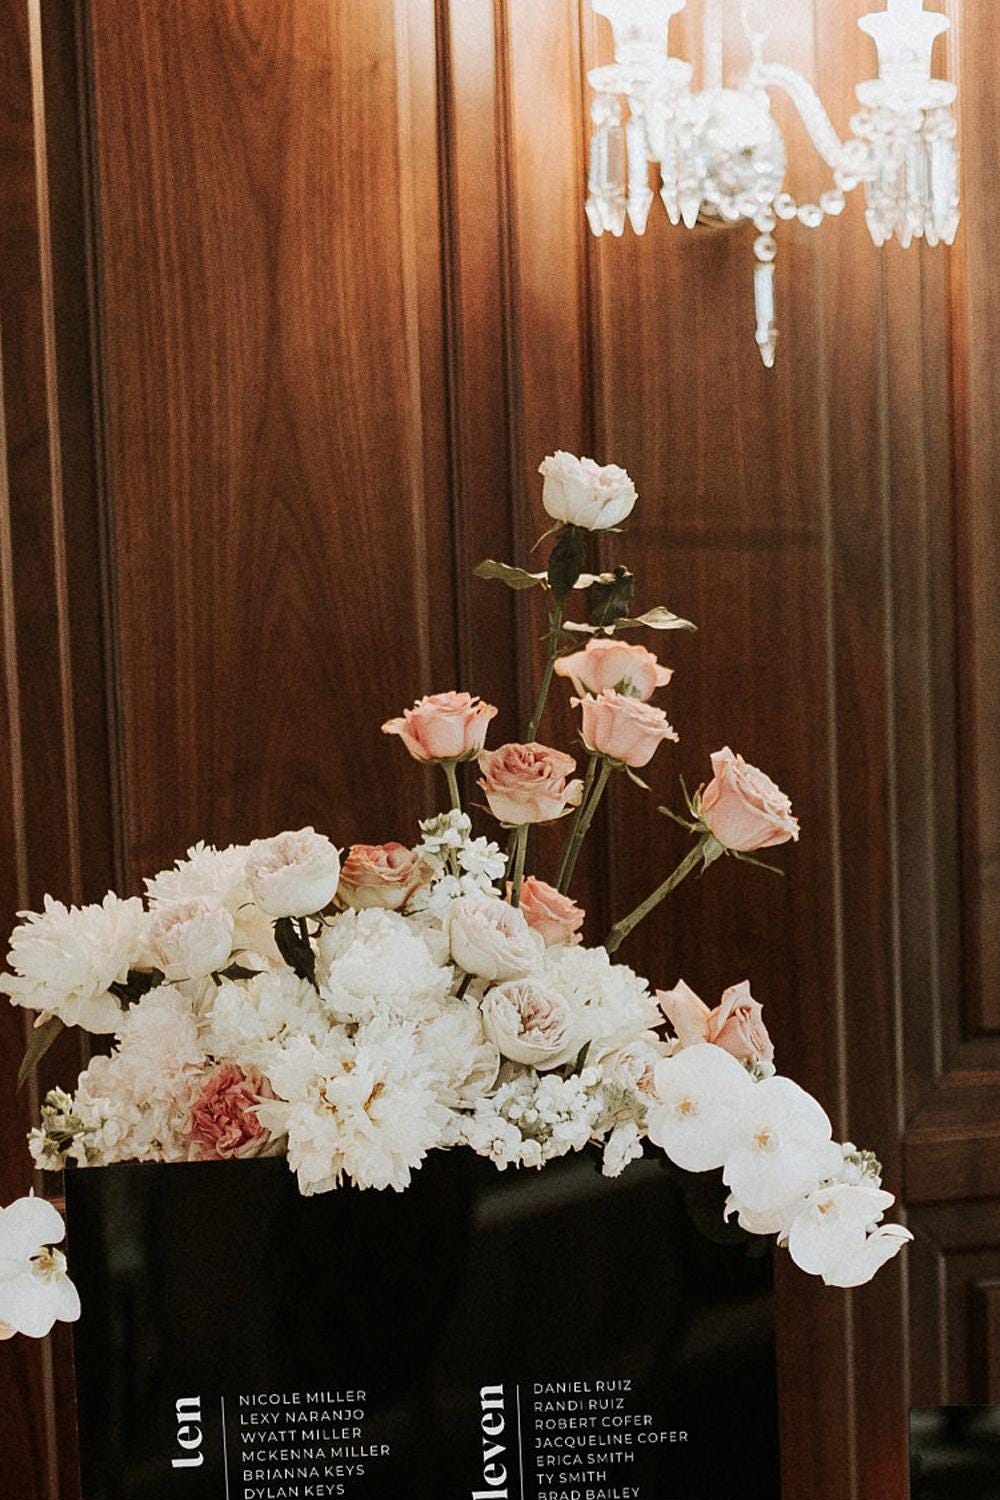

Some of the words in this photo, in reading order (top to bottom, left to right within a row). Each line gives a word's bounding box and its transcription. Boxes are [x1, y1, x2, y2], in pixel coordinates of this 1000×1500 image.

[239, 1392, 301, 1406] NICOLE
[306, 1390, 366, 1404] MILLER
[240, 1412, 280, 1425] LEXY
[285, 1409, 365, 1423] NARANJO
[172, 1396, 203, 1467] ten
[240, 1430, 297, 1443] WYATT
[302, 1427, 362, 1441] MILLER
[242, 1447, 326, 1462] MCKENNA
[331, 1444, 390, 1458] MILLER
[243, 1466, 320, 1482] BRIANNA
[324, 1464, 365, 1477] KEYS
[244, 1486, 299, 1500] DYLAN
[304, 1483, 345, 1496] KEYS
